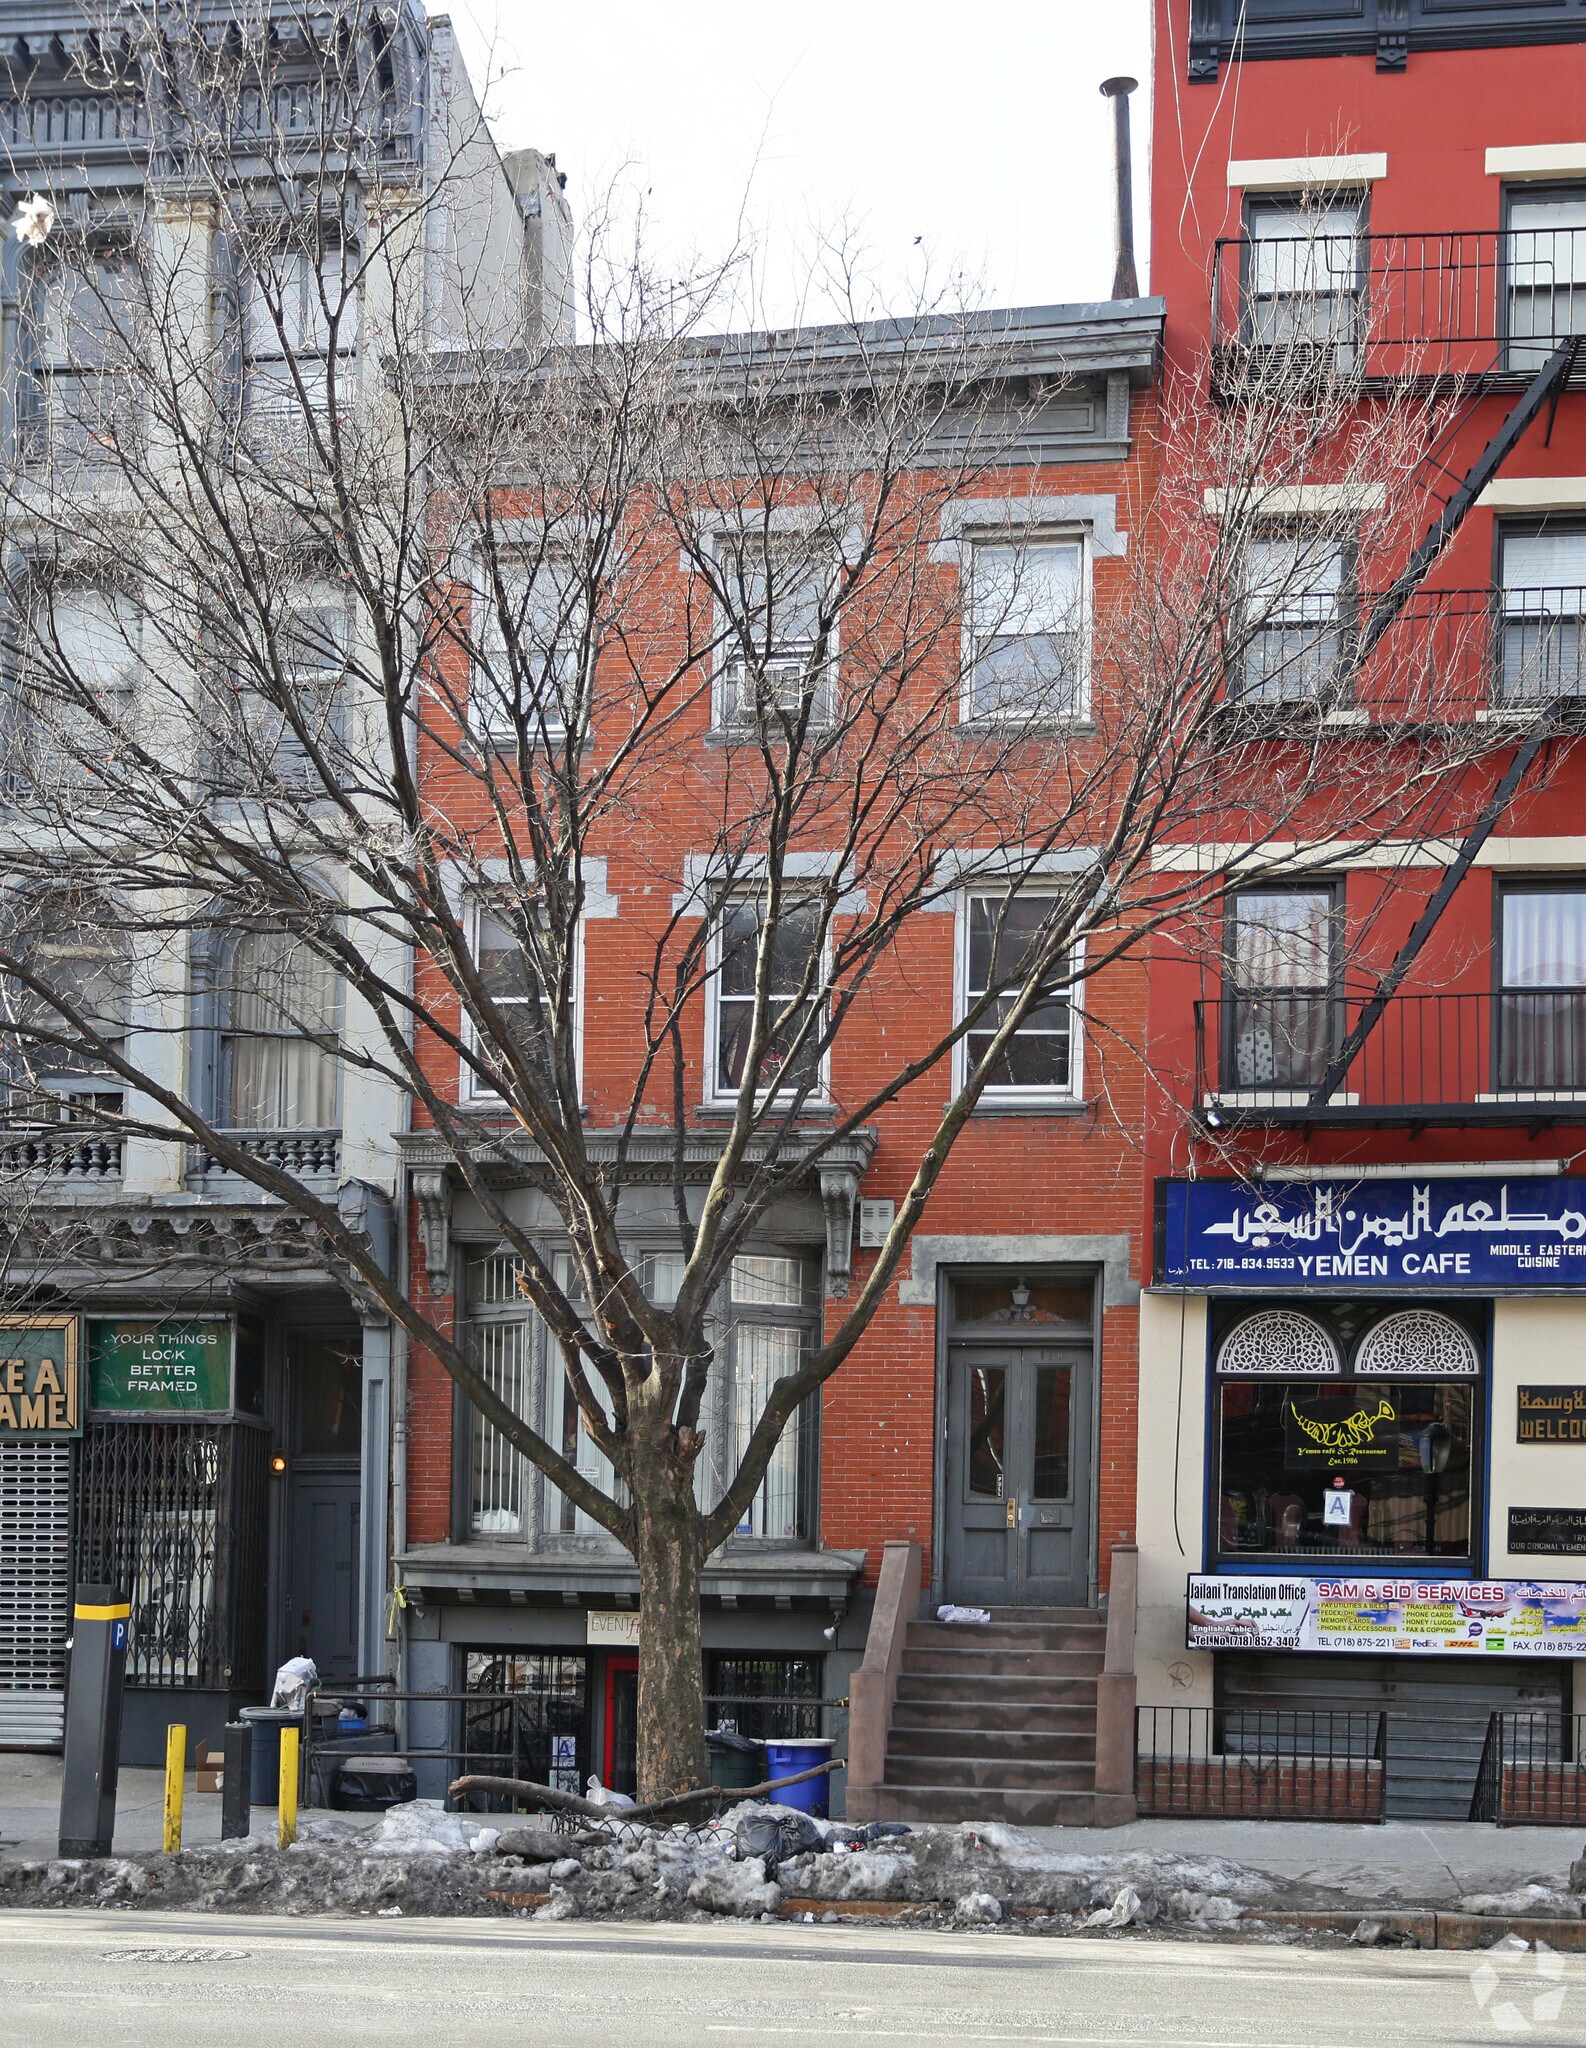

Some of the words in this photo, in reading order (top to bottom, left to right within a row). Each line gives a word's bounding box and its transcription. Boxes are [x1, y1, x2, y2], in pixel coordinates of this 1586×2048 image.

[1434, 1184, 1586, 1242] مطعم
[1490, 1244, 1531, 1256] MIDDLE
[1298, 1255, 1388, 1276] YEMEN
[1402, 1253, 1471, 1275] CAFE
[1517, 1257, 1560, 1268] CUISINE
[110, 1334, 154, 1344] YOUR
[159, 1334, 217, 1345] THINGS
[142, 1350, 186, 1360] LOOK
[33, 1359, 61, 1393] A
[130, 1365, 196, 1376] BETTER
[127, 1381, 198, 1392] FRAMED
[1297, 1447, 1321, 1456] Yemen
[1348, 1447, 1387, 1456] Restaurant
[1329, 1496, 1345, 1515] A
[1510, 1541, 1525, 1550] OUR
[1527, 1542, 1559, 1551] ORIGINAL
[1190, 1583, 1220, 1599] Jailani
[1223, 1584, 1276, 1600] Translation
[1278, 1584, 1306, 1600] Office
[1319, 1583, 1358, 1599] SAM
[1364, 1584, 1376, 1598] &
[1382, 1585, 1411, 1599] SID
[1417, 1586, 1504, 1600] SERVICES
[117, 1623, 124, 1646] P
[1229, 1635, 1253, 1647] (718)
[1254, 1636, 1300, 1647] 852-3402
[1334, 1637, 1355, 1647] (718)
[1357, 1638, 1395, 1647] 875-2211
[1412, 1639, 1438, 1648] FedEx
[1534, 1641, 1555, 1651] (718)
